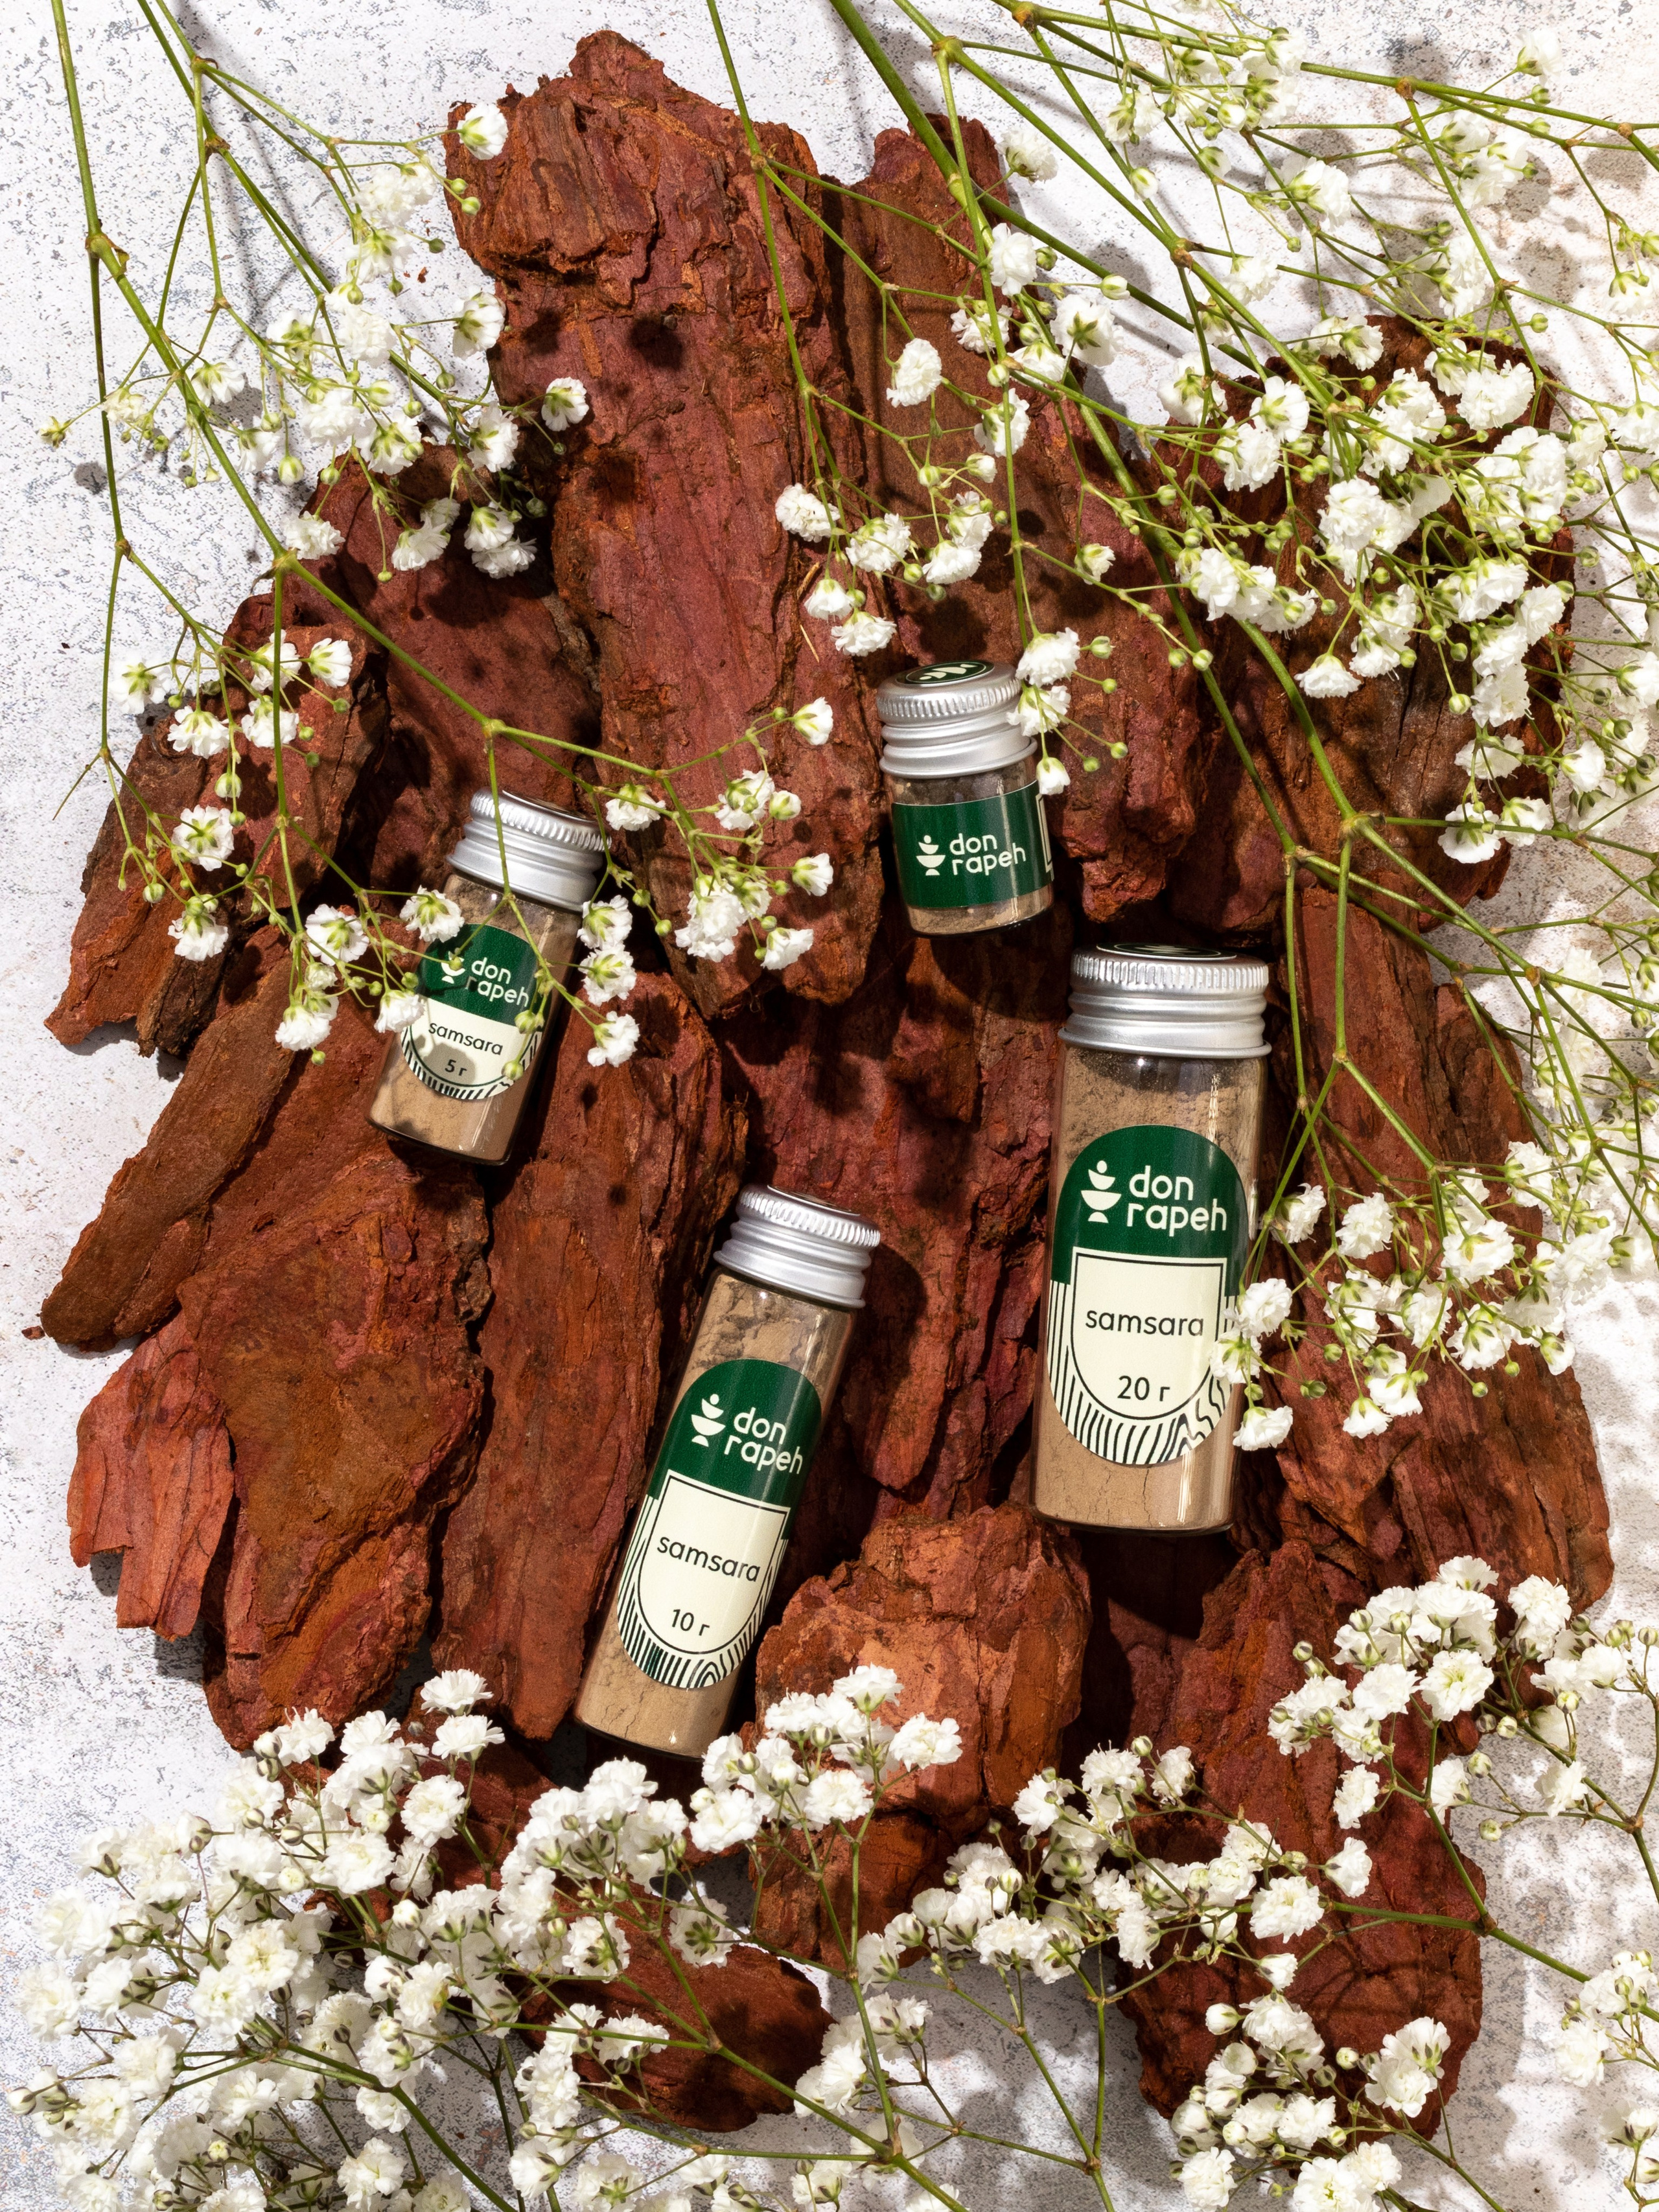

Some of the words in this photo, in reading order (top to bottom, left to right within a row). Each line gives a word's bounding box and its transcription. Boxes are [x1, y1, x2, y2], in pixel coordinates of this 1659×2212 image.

[949, 833, 997, 855] don
[952, 842, 1026, 876] rapeh
[471, 957, 511, 984] don
[465, 976, 529, 1008] rapeh
[428, 1022, 503, 1055] samsara
[445, 1059, 457, 1073] 5
[1129, 1165, 1194, 1201] don
[1126, 1198, 1227, 1237] rapeh
[1085, 1310, 1203, 1336] samsara
[1117, 1375, 1150, 1401] 20
[734, 1407, 787, 1445] don
[724, 1434, 803, 1475] rapeh
[657, 1536, 760, 1582] samsara
[671, 1609, 695, 1631] 10
